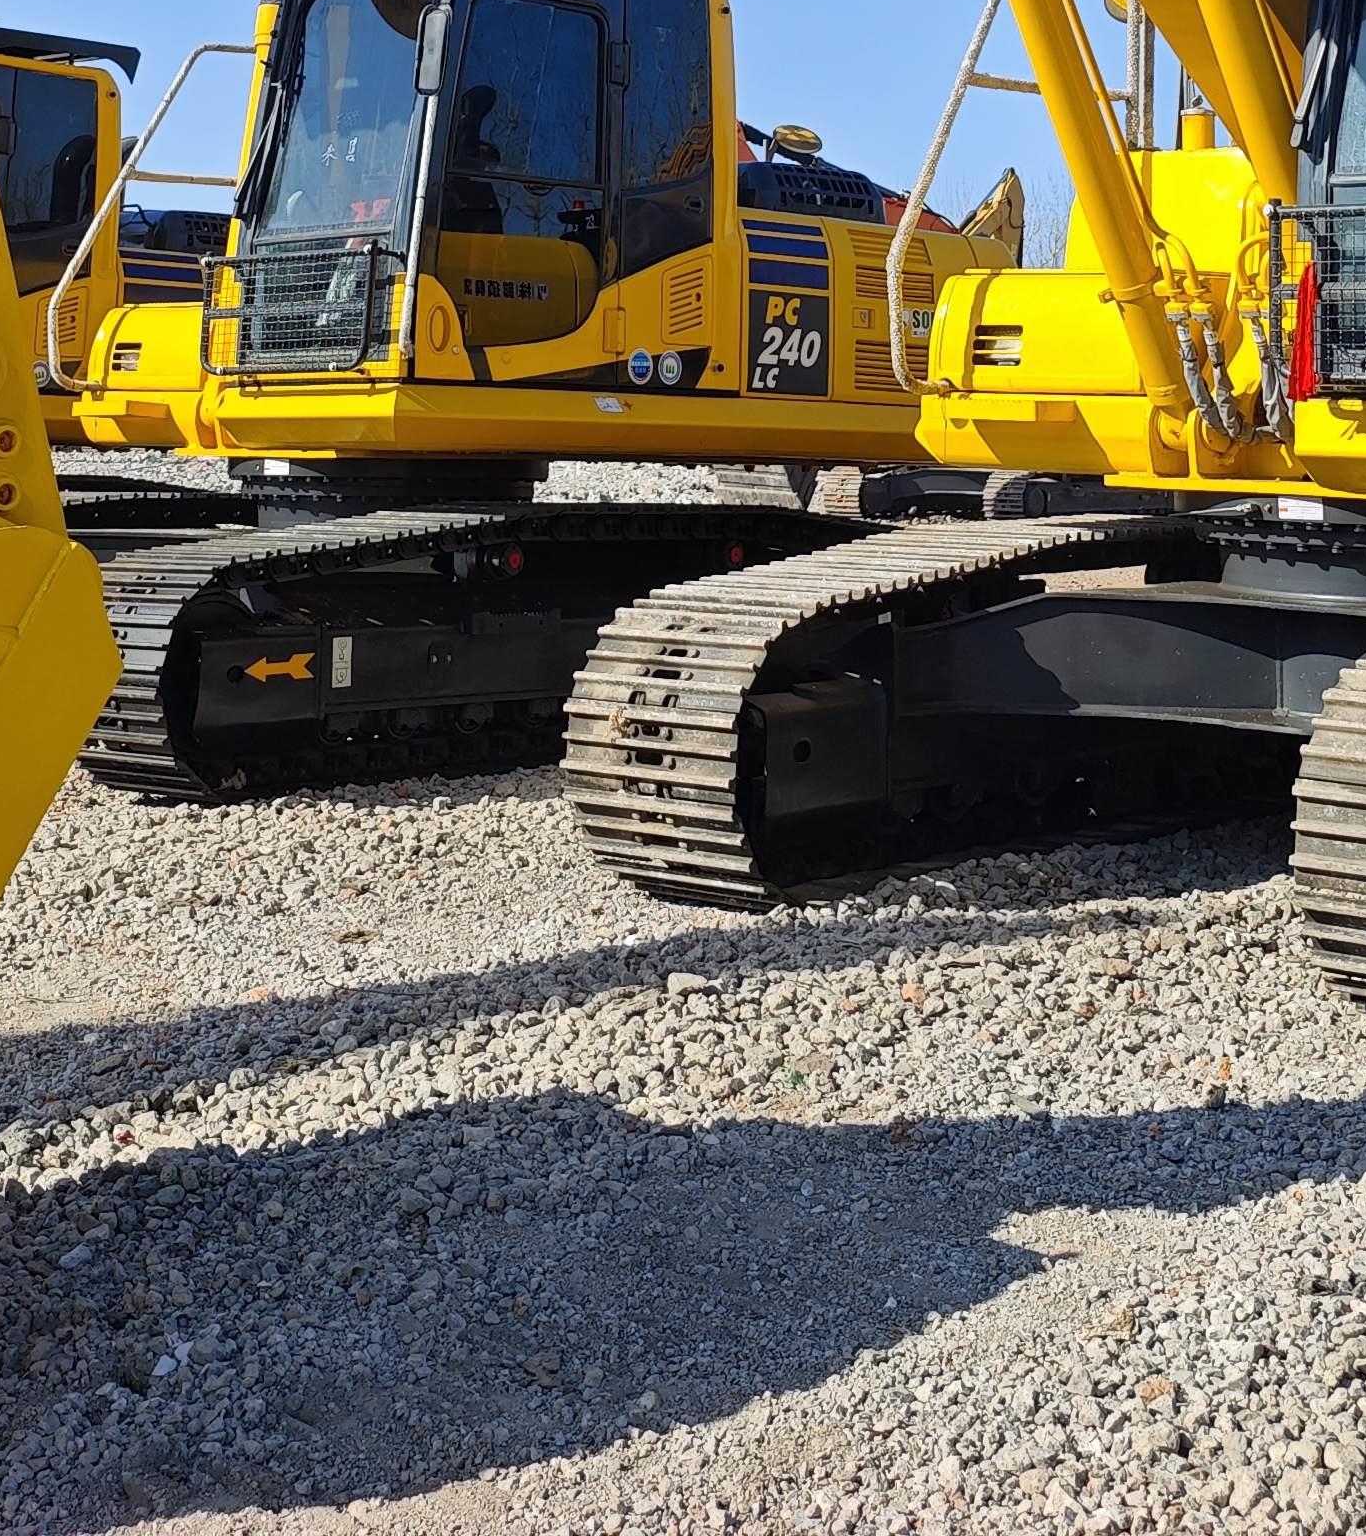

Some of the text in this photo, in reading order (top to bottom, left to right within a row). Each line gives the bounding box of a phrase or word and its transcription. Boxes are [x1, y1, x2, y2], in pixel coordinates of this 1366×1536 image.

[765, 296, 801, 326] PC
[756, 326, 822, 368] 240
[751, 368, 778, 389] LC
